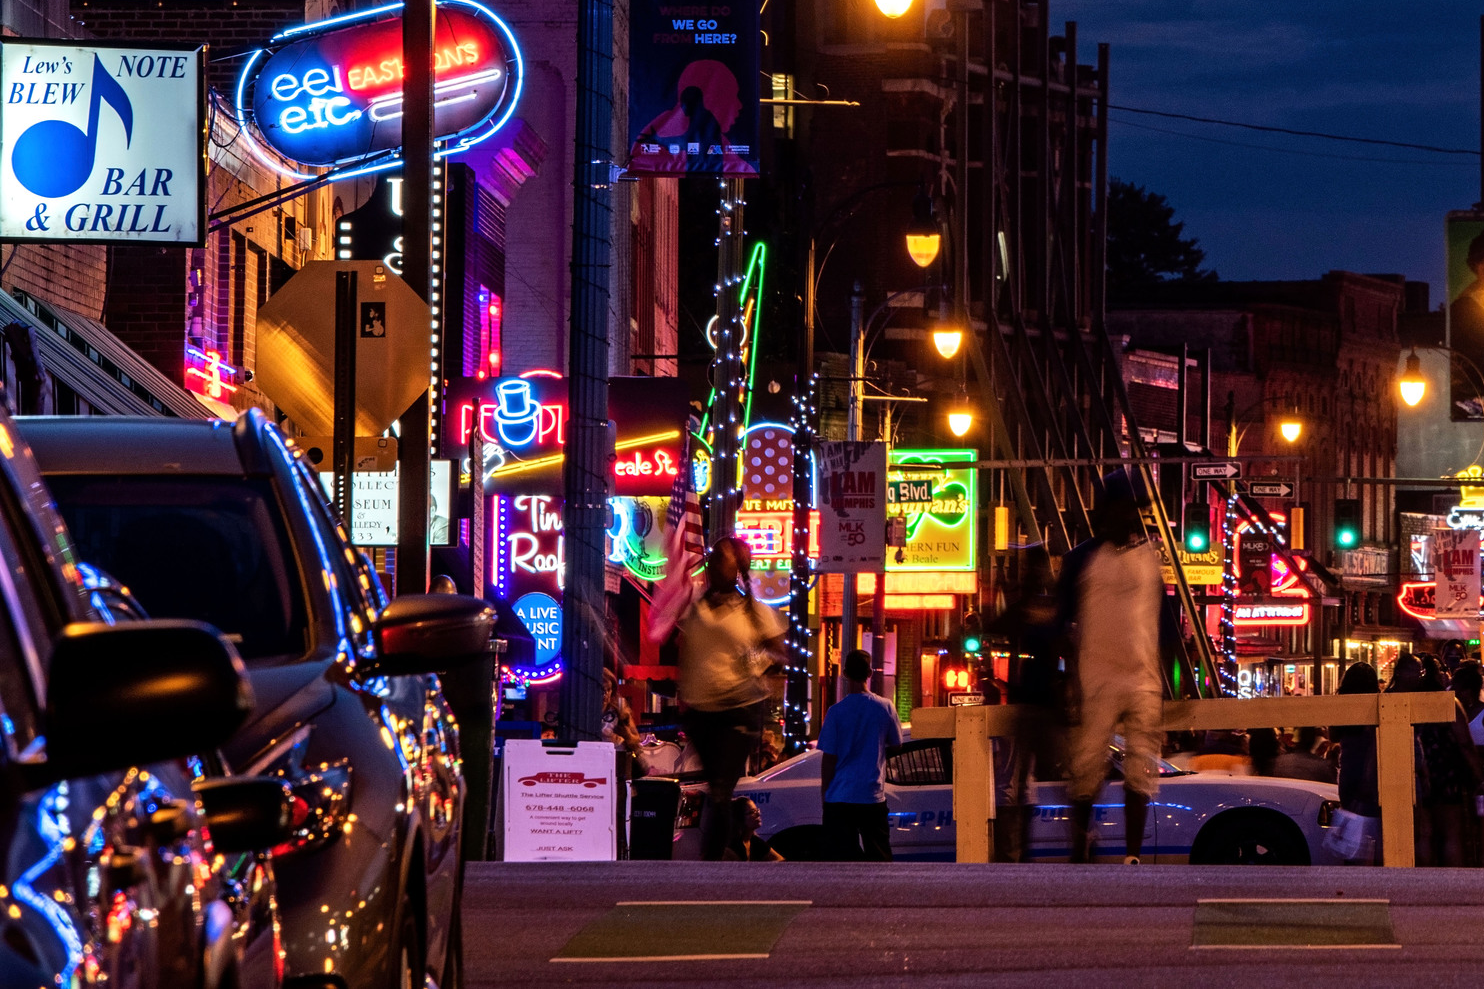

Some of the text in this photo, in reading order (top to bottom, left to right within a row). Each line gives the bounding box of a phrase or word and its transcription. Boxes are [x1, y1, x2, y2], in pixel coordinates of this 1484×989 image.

[672, 19, 718, 30] WE GO
[653, 32, 737, 44] FROM HERE?
[22, 55, 188, 79] Lew's NOTE
[8, 82, 86, 105] BLEW
[99, 167, 173, 197] BAR
[25, 202, 172, 233] & GRILL
[614, 451, 653, 477] eale
[844, 471, 876, 493] AM
[900, 482, 931, 502] Blvd.
[514, 495, 563, 533] Tin
[838, 521, 865, 533] MLK
[936, 542, 960, 552] FUN
[911, 554, 939, 564] Beale
[529, 606, 558, 620] LIVE
